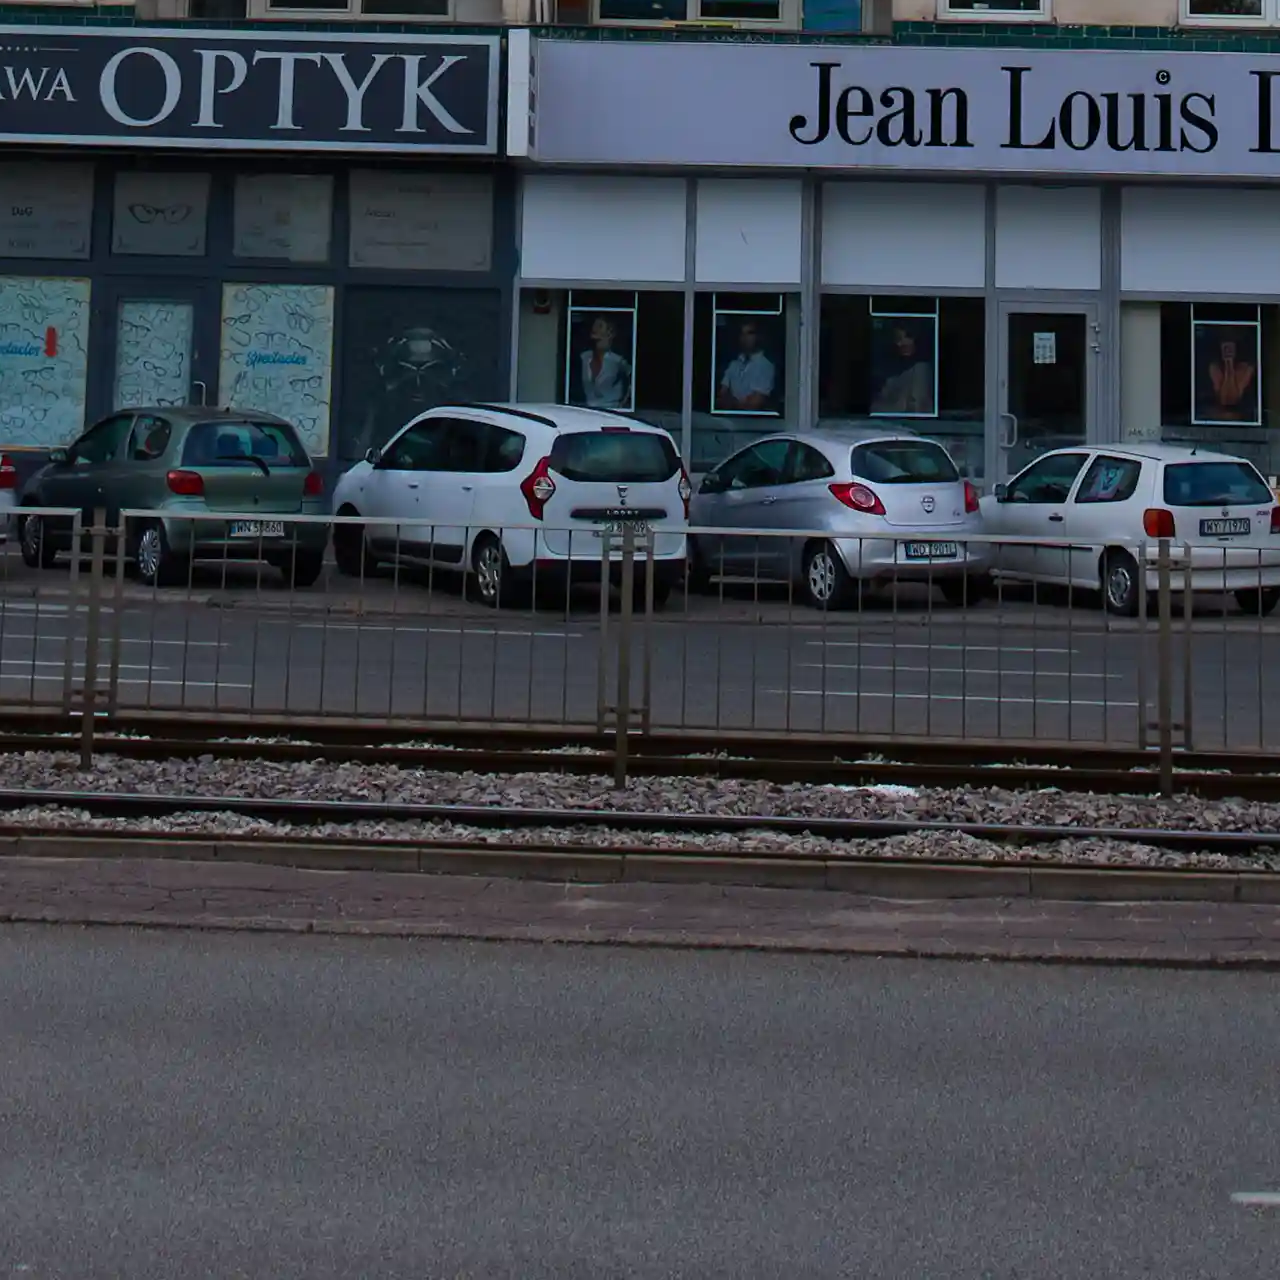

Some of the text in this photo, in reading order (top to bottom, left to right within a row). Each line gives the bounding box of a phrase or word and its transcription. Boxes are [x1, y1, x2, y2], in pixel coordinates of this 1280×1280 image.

[99, 46, 476, 135] OPTYK
[789, 62, 974, 147] Jean
[1000, 66, 1219, 153] Louis
[237, 521, 251, 533] WN
[1206, 521, 1220, 533] WY
